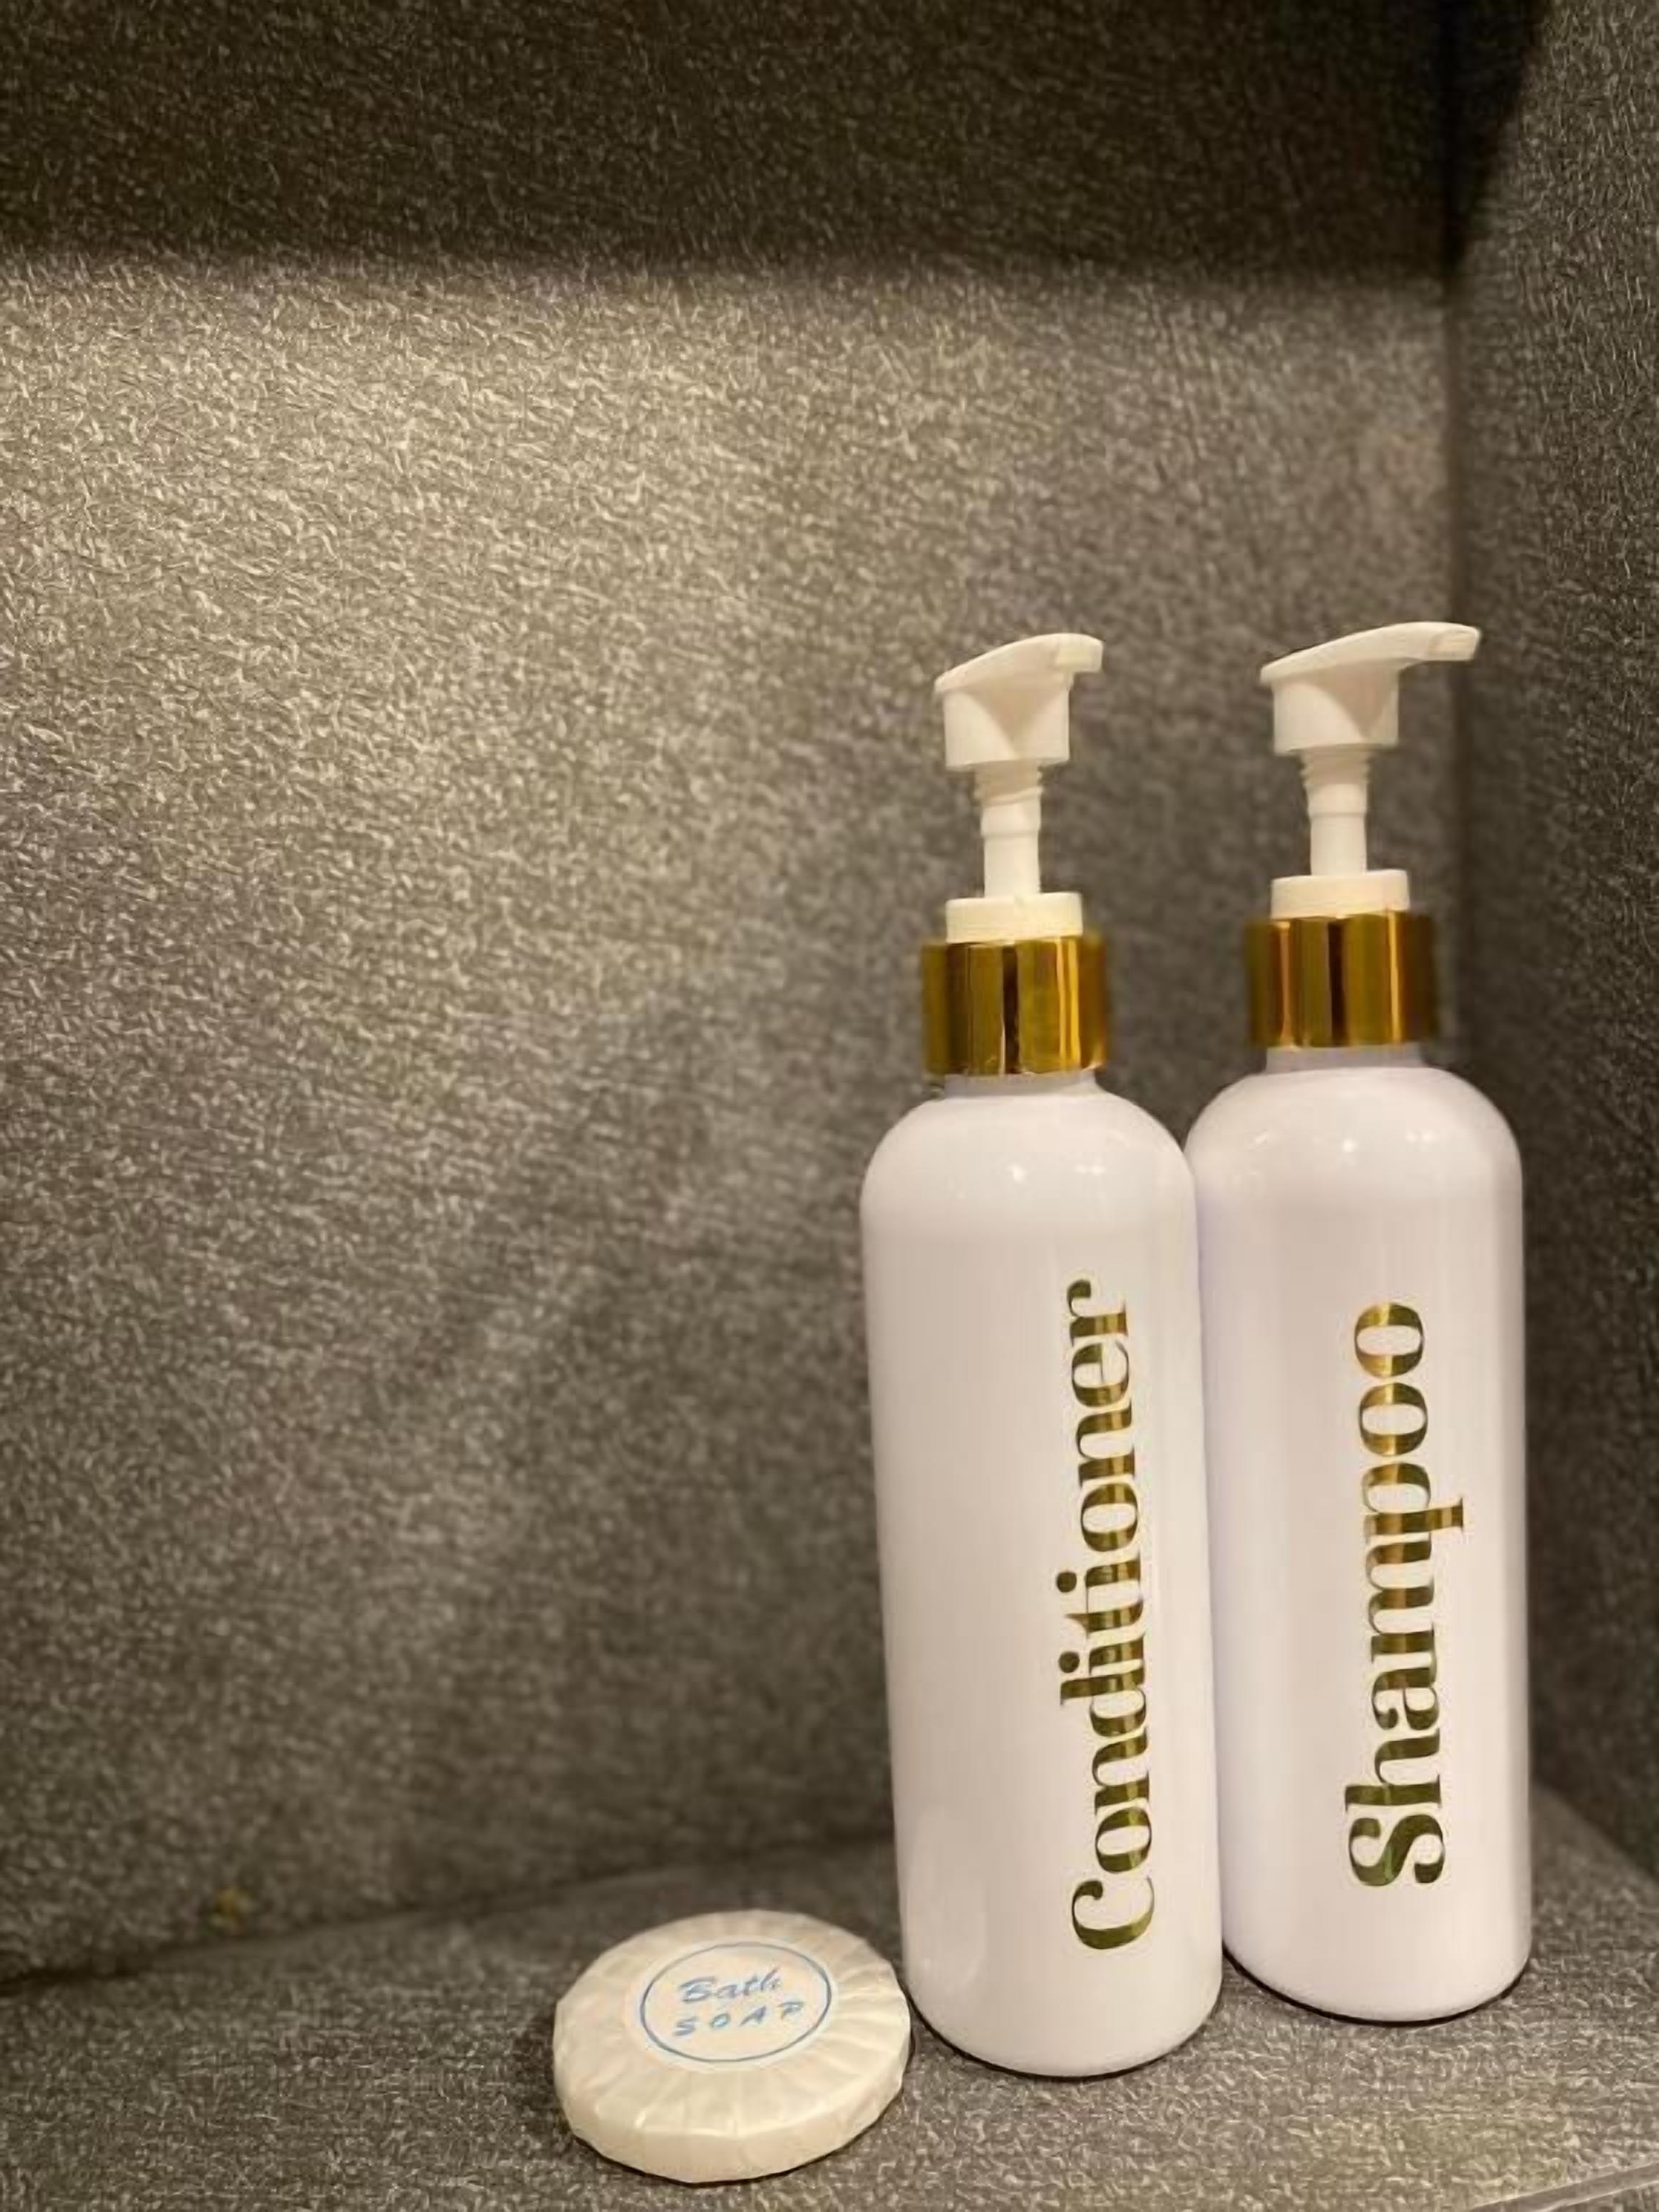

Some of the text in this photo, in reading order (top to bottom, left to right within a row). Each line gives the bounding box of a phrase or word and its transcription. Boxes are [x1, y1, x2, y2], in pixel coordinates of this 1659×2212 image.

[1055, 1279, 1155, 1951] Conditioner
[1344, 1301, 1465, 1887] Shampoo
[673, 2000, 806, 2037] SOAP
[679, 1966, 782, 2004] Bath
